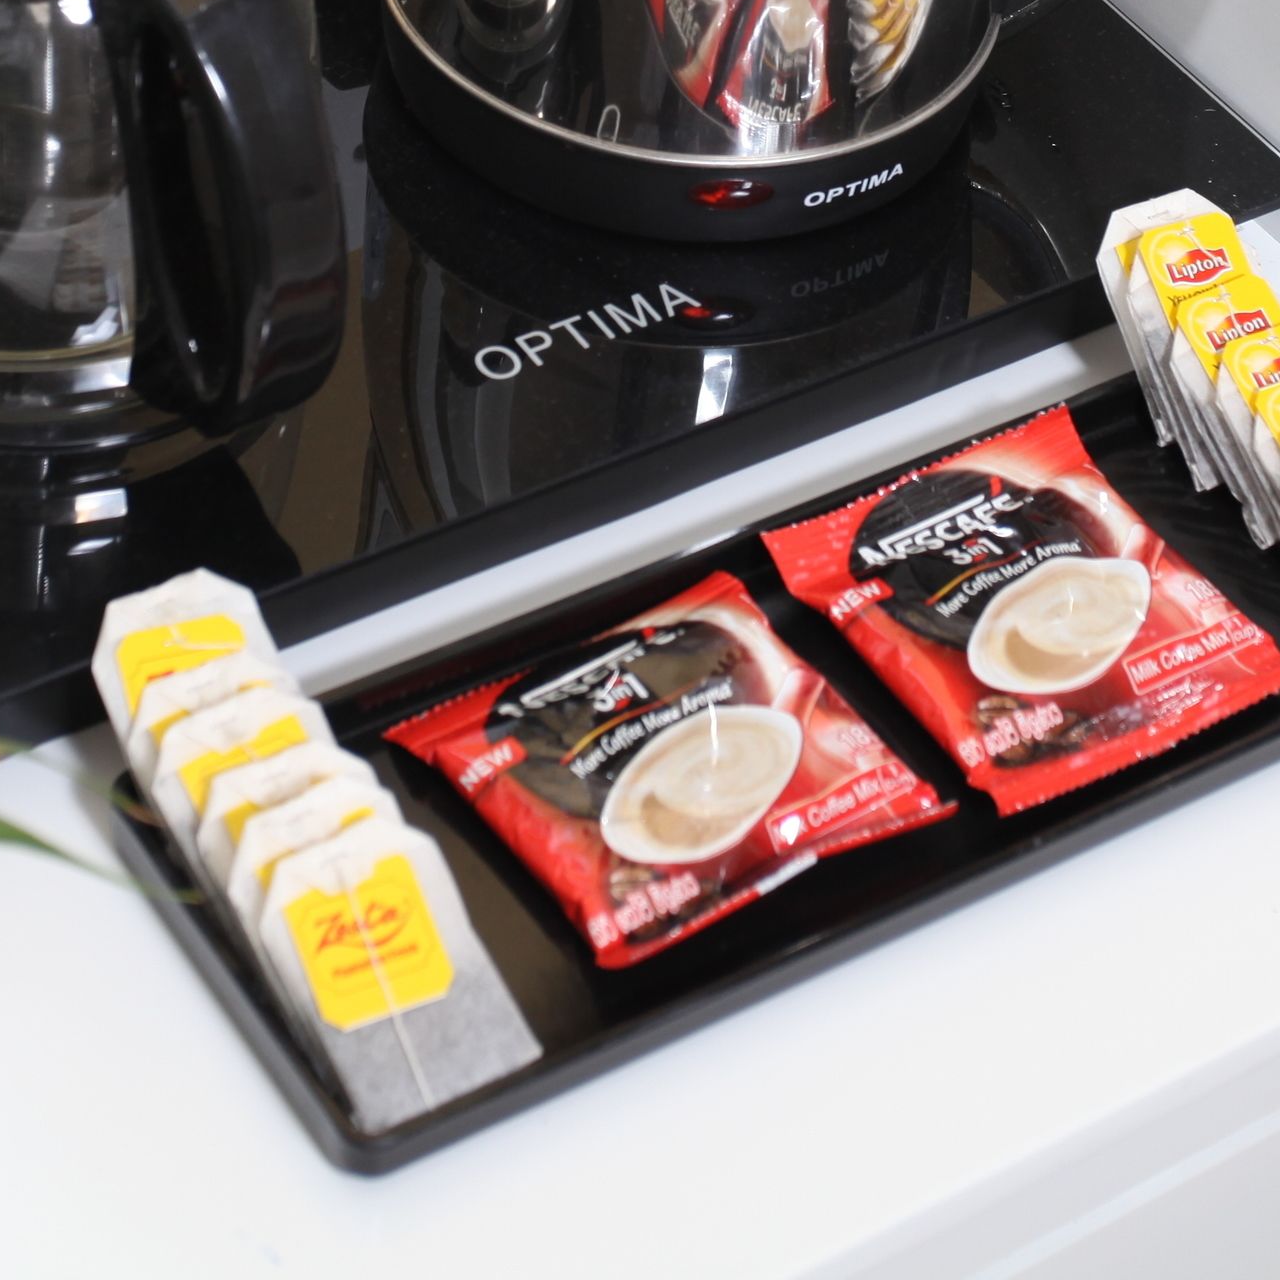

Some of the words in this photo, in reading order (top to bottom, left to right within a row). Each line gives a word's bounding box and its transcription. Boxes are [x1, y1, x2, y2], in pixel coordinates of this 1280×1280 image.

[803, 163, 904, 207] OPTIMA
[1171, 255, 1227, 279] Lipton
[474, 283, 702, 380] OPTIMA
[830, 582, 881, 620] NEW
[935, 591, 969, 618] More
[962, 572, 1002, 598] Coffee
[1000, 554, 1036, 580] More
[1035, 541, 1081, 563] Aroma
[1200, 630, 1231, 652] Mix
[571, 748, 607, 779] More
[600, 724, 646, 756] Coffee
[641, 709, 681, 733] More
[681, 683, 733, 715] Aroma
[459, 742, 514, 792] NEW
